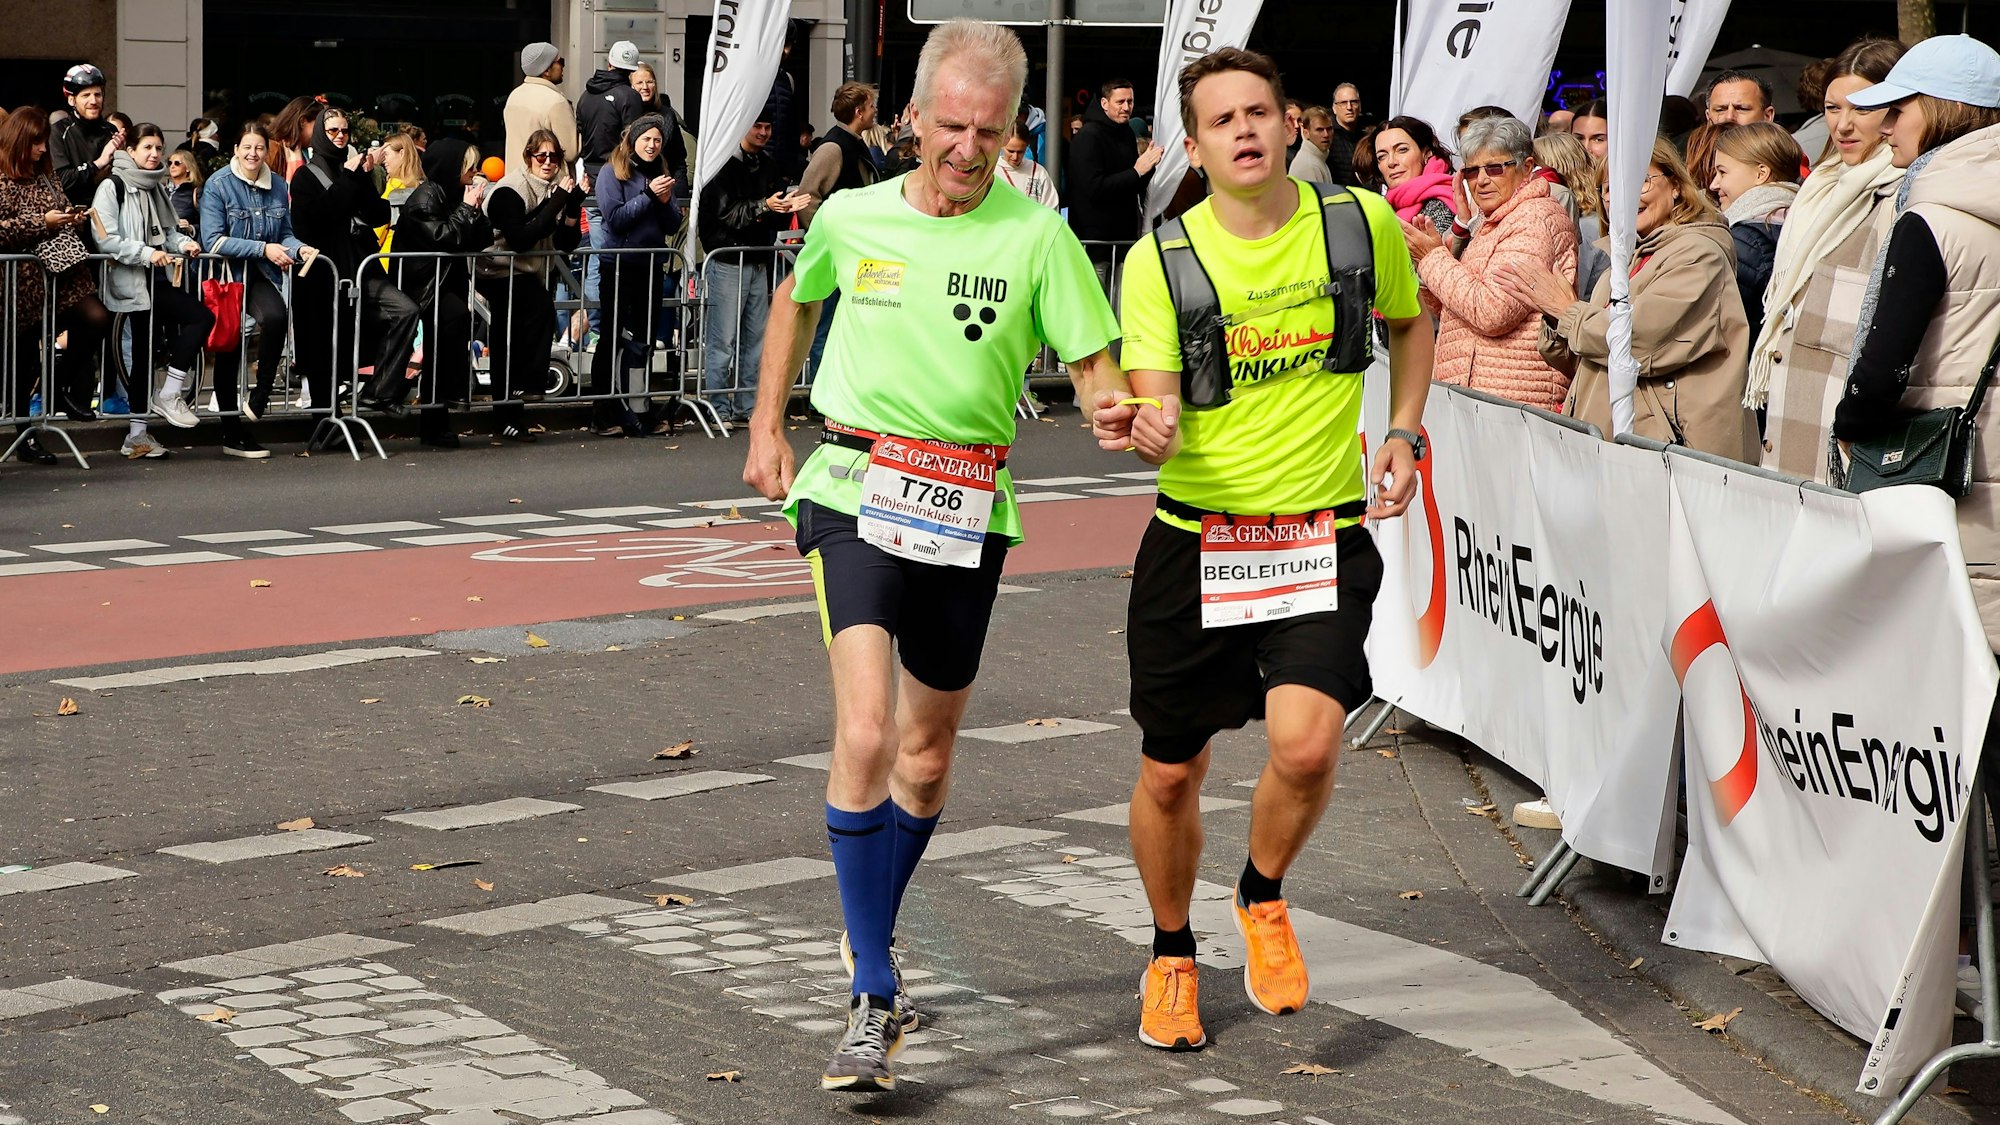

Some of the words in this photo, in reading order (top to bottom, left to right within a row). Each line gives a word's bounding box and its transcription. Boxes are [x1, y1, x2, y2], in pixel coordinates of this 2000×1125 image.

[1446, 1, 1494, 60] ie
[673, 48, 681, 63] 5
[947, 272, 1008, 303] BLIND
[1247, 279, 1315, 301] Zusammen
[907, 449, 994, 483] GENERALI
[900, 476, 964, 511] T786
[871, 493, 962, 525] R(h)einInklusiv
[966, 517, 980, 528] 17
[1236, 520, 1332, 543] GENERALI
[913, 542, 937, 556] PUMA
[1204, 556, 1333, 581] BEGLEITUNG
[1266, 606, 1291, 616] PUMA
